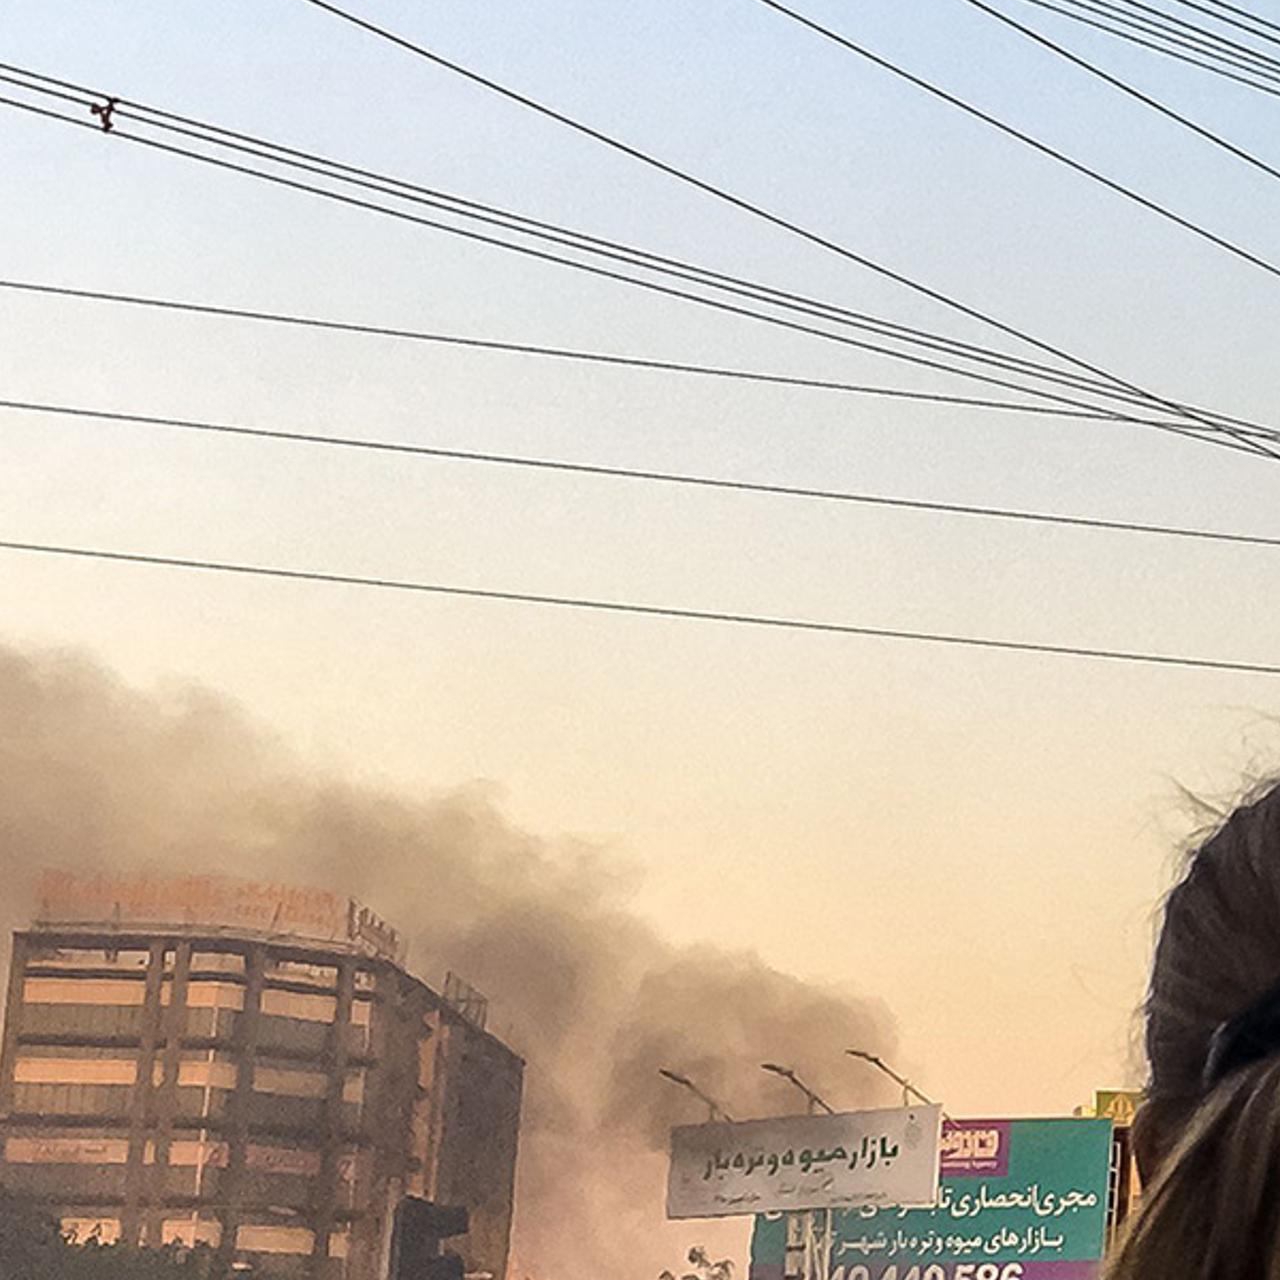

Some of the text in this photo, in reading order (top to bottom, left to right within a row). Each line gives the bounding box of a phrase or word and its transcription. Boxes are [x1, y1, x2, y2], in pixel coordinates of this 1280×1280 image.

[767, 1153, 779, 1176] و
[781, 1146, 847, 1173] میوه
[847, 1136, 899, 1170] بازار
[950, 1184, 1039, 1217] انحصاری
[1032, 1191, 1098, 1215] مجری
[837, 1231, 887, 1256] شهر
[933, 1236, 944, 1256] و
[944, 1234, 982, 1256] میوه
[982, 1226, 1064, 1255] بازارهای
